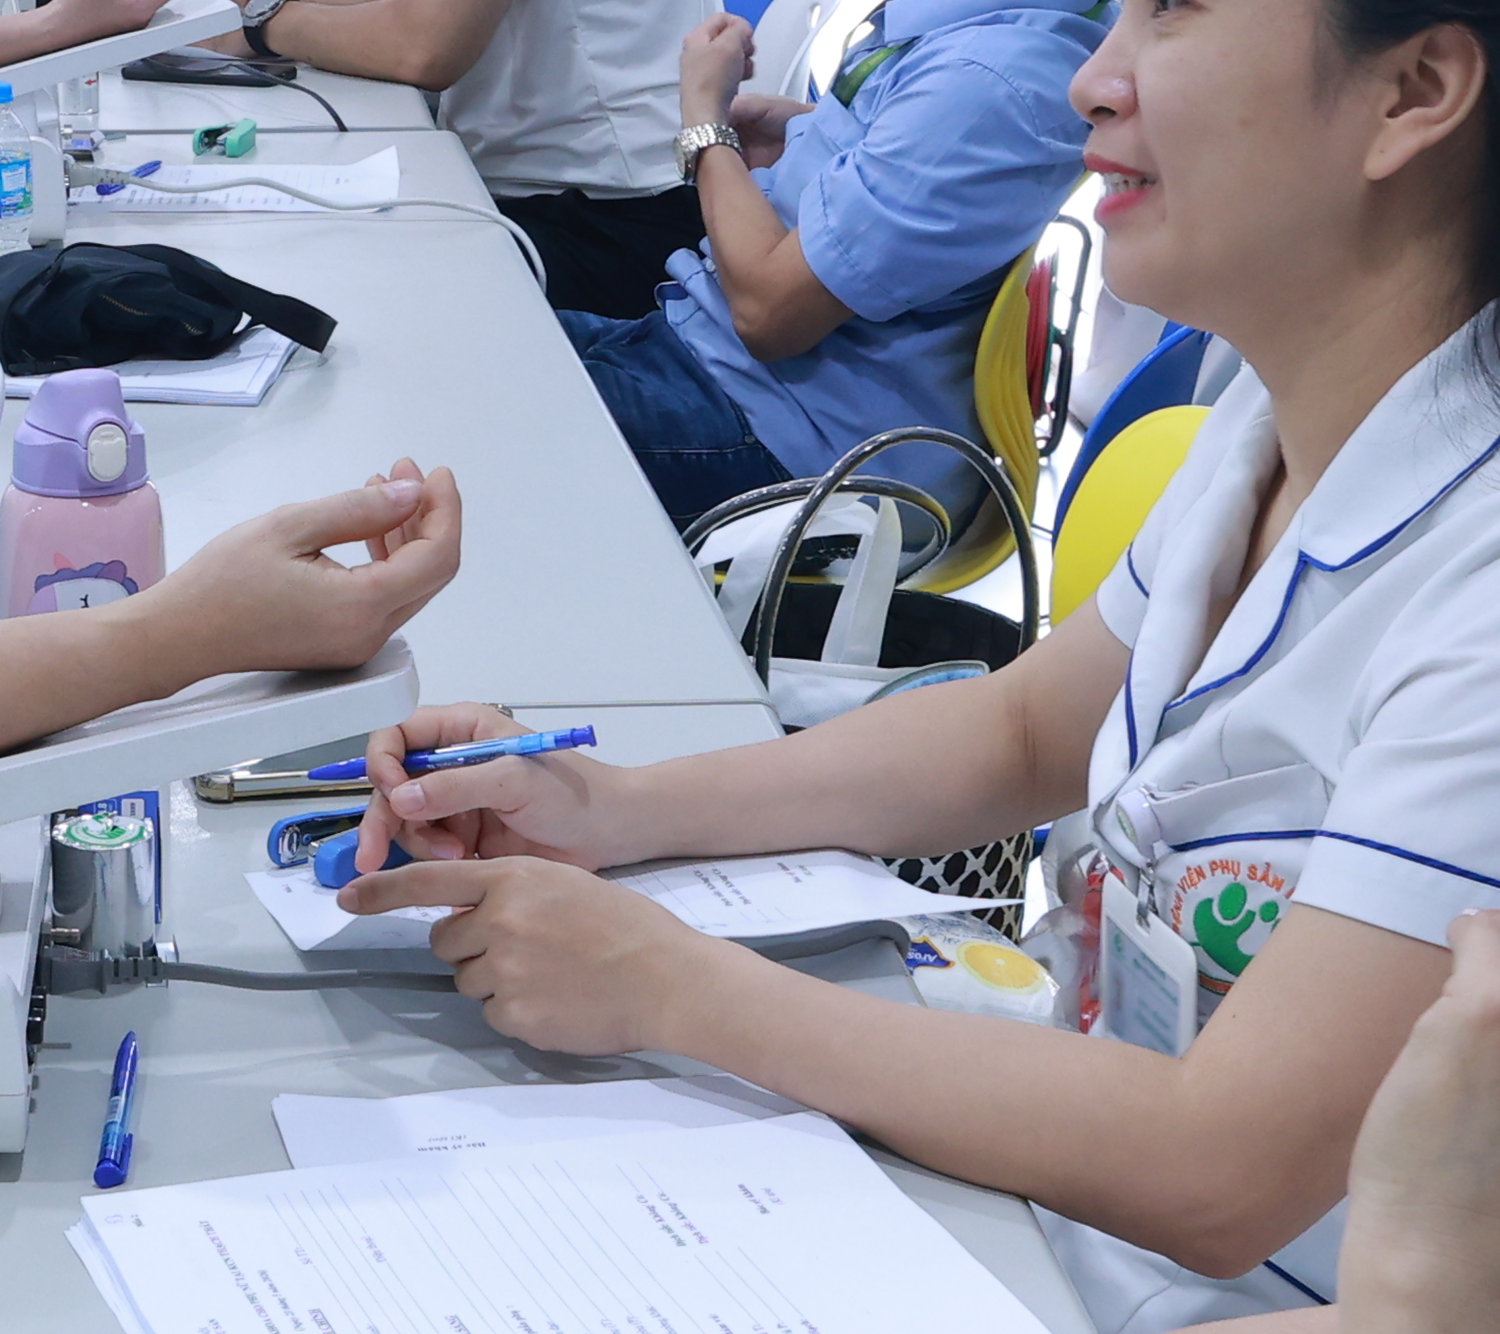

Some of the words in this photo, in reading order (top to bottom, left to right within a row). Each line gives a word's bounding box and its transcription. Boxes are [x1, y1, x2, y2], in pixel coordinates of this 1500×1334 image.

[1177, 860, 1207, 895] VIỆN
[1208, 859, 1242, 881] PHỤ
[1246, 861, 1286, 892] SẢN
[906, 951, 938, 964] Aros
